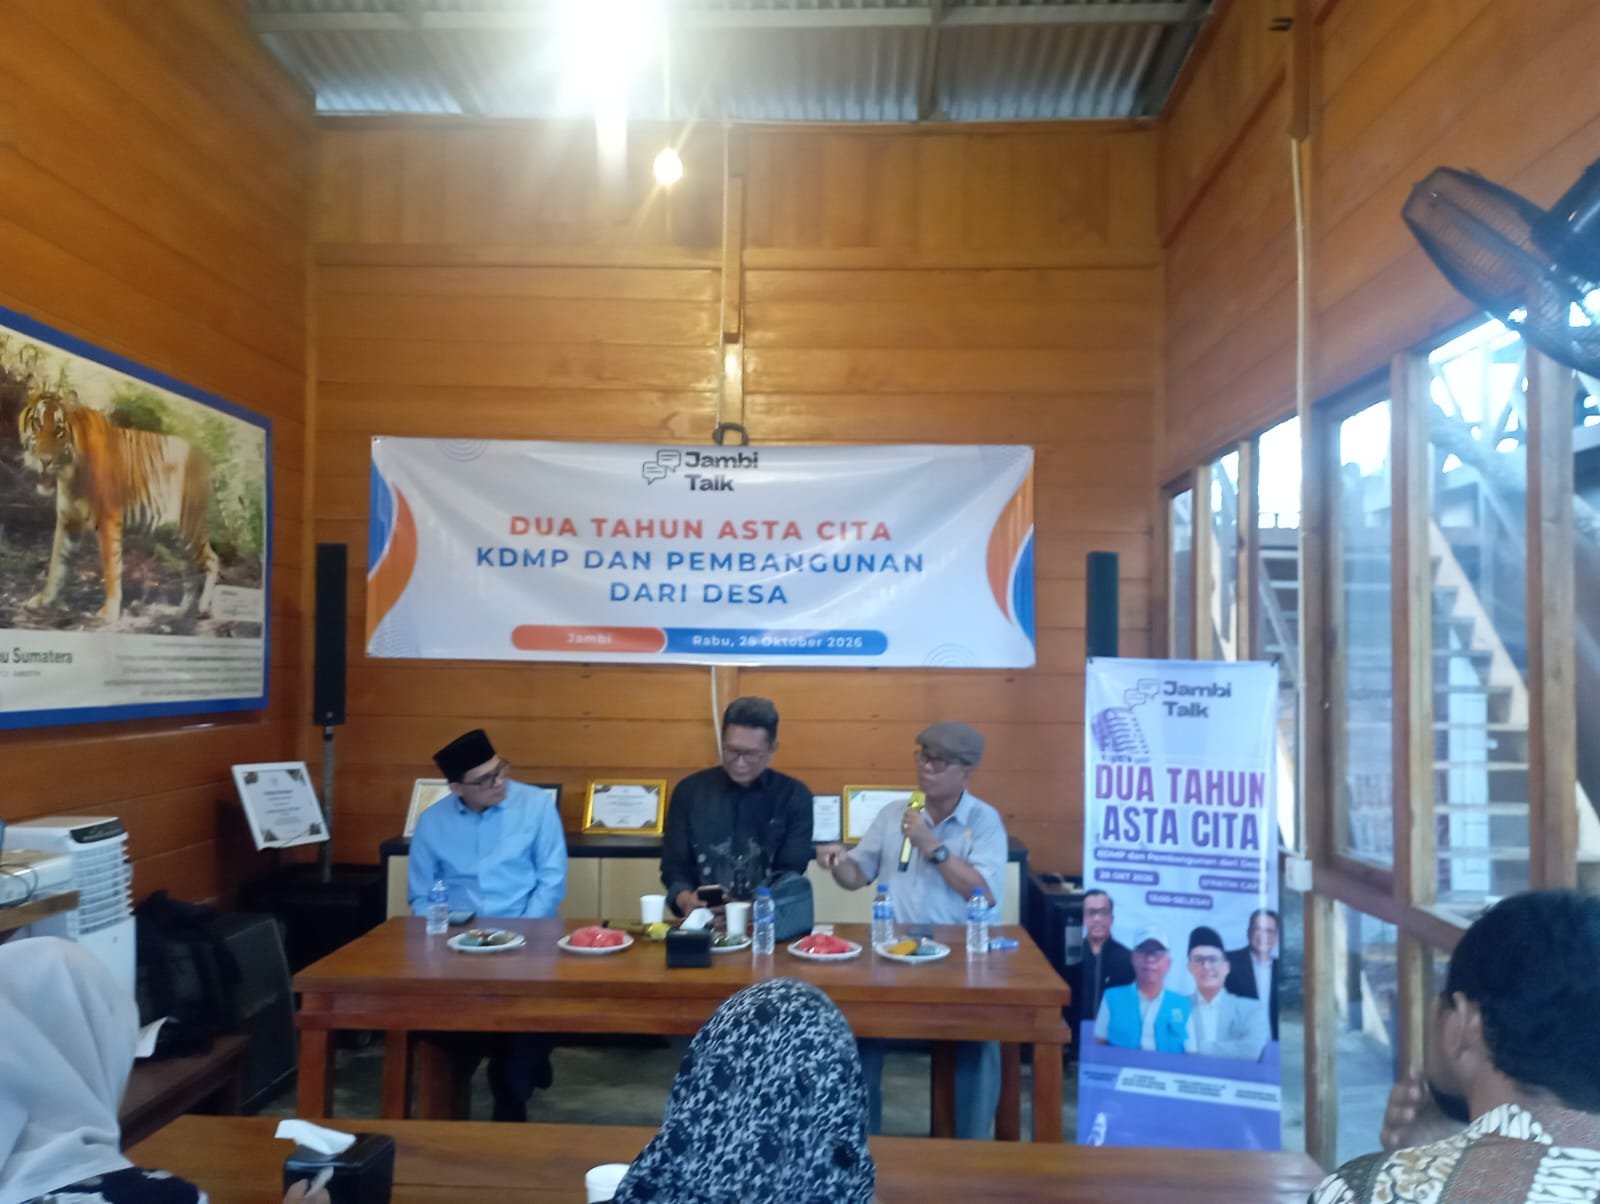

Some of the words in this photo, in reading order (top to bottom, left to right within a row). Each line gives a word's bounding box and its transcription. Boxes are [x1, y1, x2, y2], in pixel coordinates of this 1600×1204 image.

[685, 451, 759, 469] Jambi
[685, 473, 734, 491] Talk
[509, 516, 577, 536] DUA
[591, 518, 703, 539] TAHUN
[717, 520, 801, 541] ASTA
[816, 521, 891, 541] CITA
[476, 547, 569, 568] KDMP
[583, 550, 651, 570] DAN
[666, 551, 923, 573] PEMBANGUNAN
[610, 582, 687, 602] DARI
[702, 583, 788, 604] DESA
[567, 632, 612, 645] Jambi
[692, 635, 735, 648] Rabu,
[760, 635, 823, 648] Oktober
[13, 647, 73, 664] Sumatera
[1162, 681, 1232, 698] Jambi
[1162, 701, 1209, 718] Talk
[1095, 764, 1154, 802] DUA
[1166, 768, 1265, 808] TAHUN
[1102, 805, 1179, 845] ASTA
[1191, 811, 1260, 850] CITA
